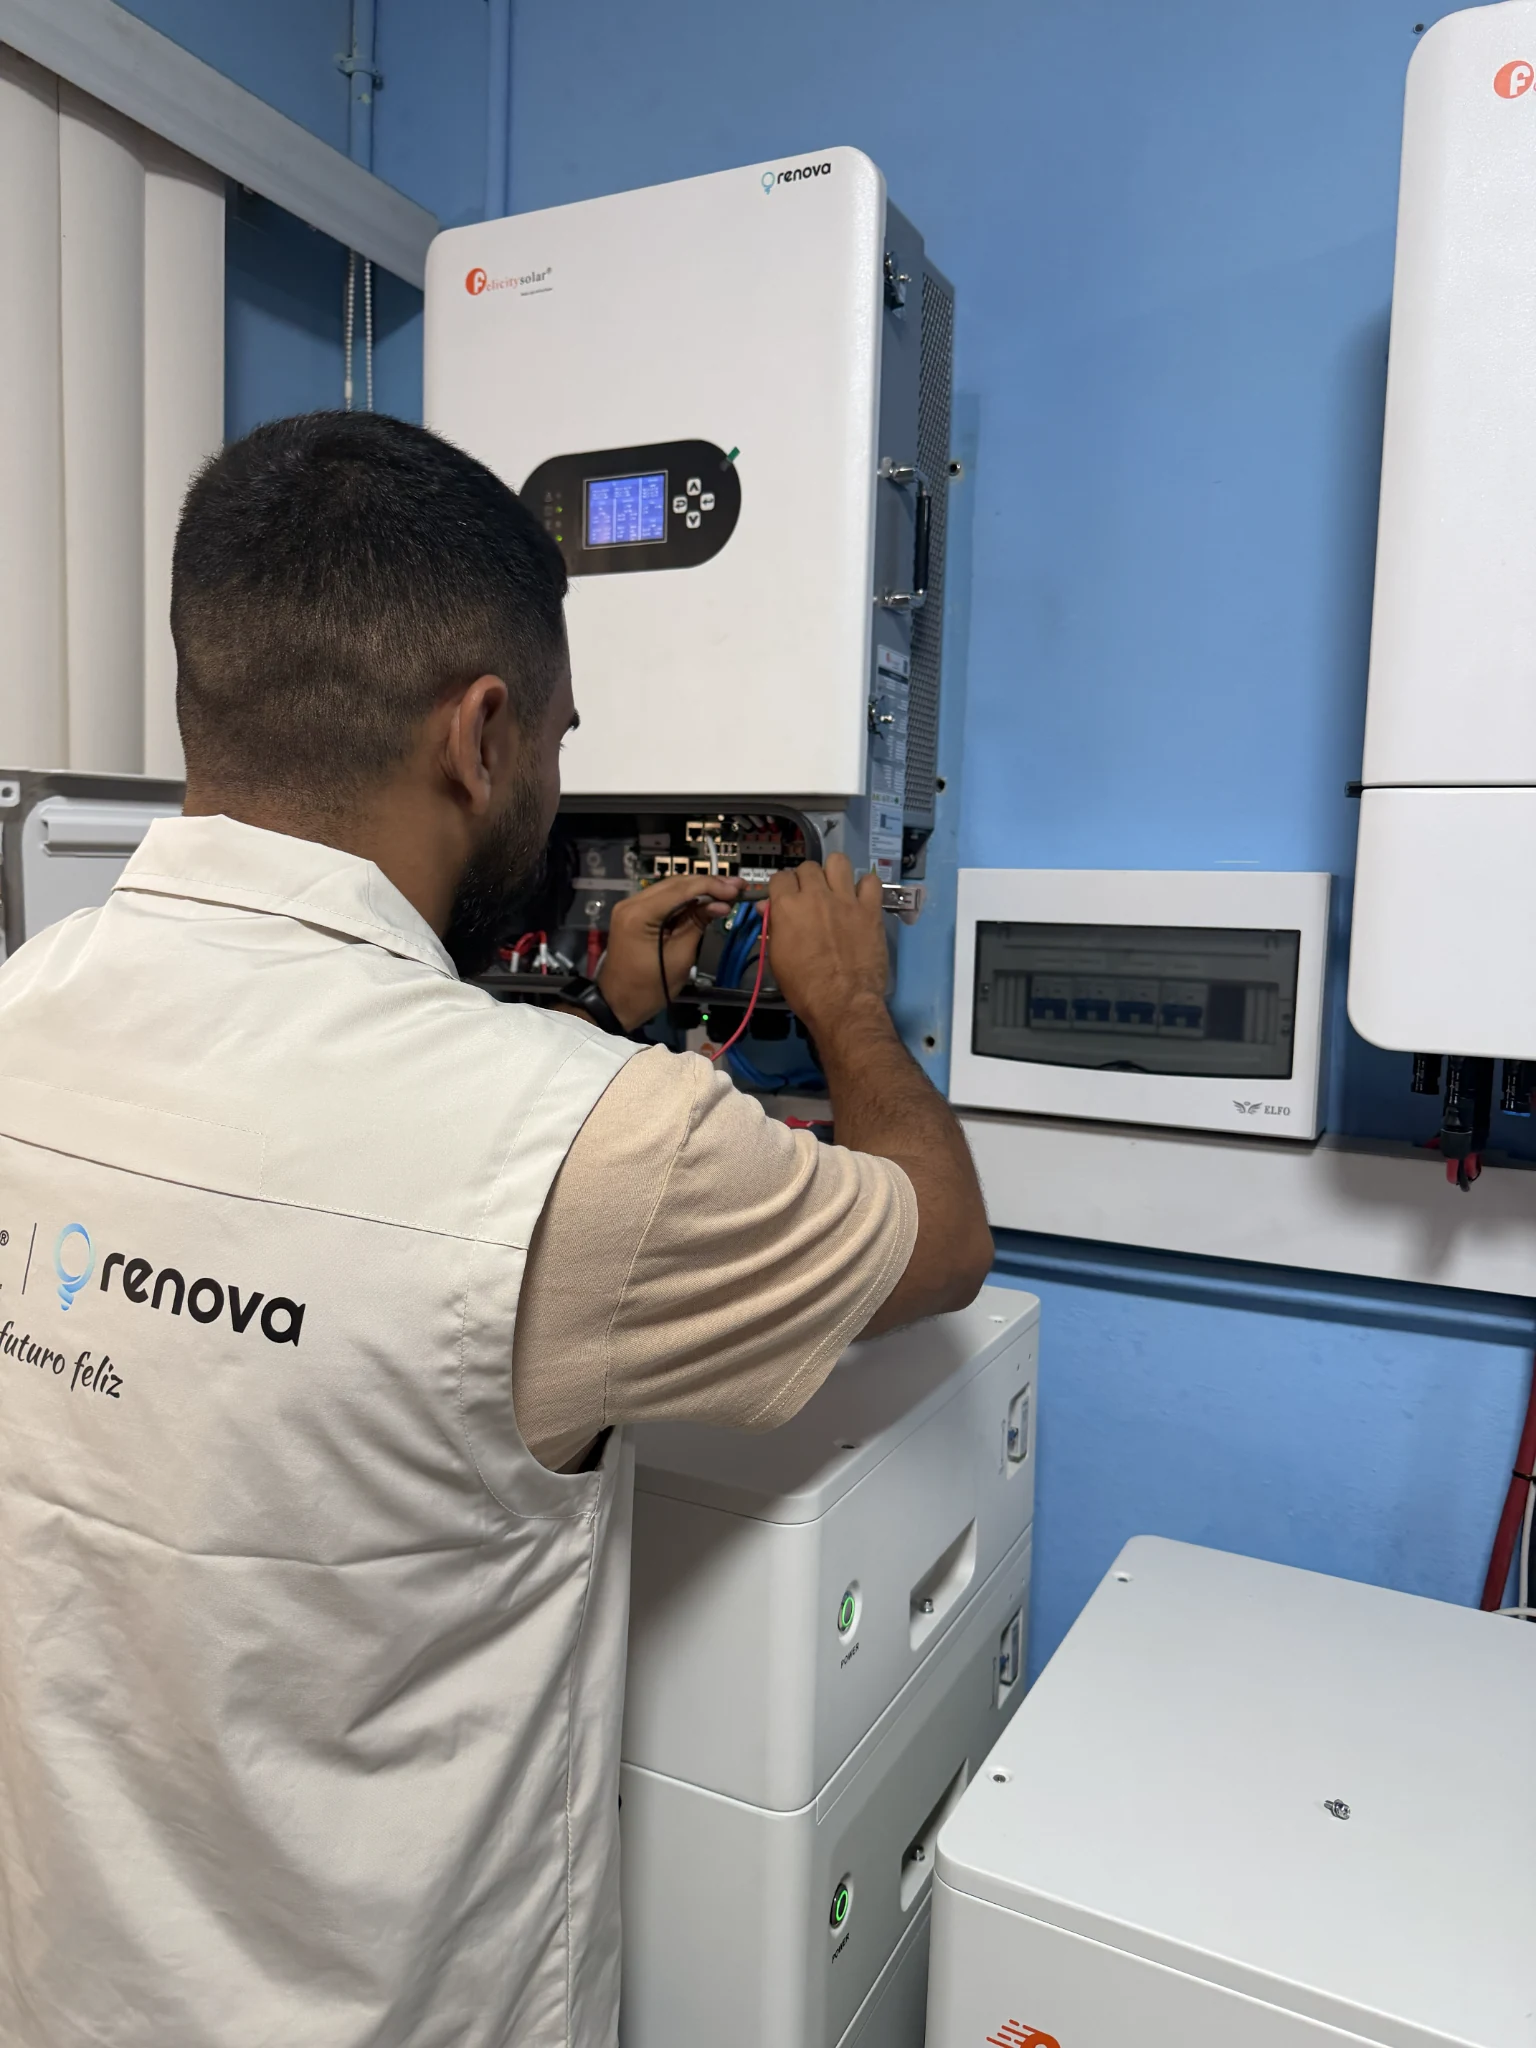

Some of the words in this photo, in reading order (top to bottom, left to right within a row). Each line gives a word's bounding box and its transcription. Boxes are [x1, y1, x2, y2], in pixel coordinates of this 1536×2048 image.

[777, 162, 832, 184] renova
[1264, 1105, 1291, 1116] ELFO
[100, 1252, 306, 1347] renova
[0, 1320, 66, 1375] futuro
[70, 1351, 124, 1399] feliz
[840, 1642, 860, 1669] POWER
[831, 1932, 850, 1964] POWER
